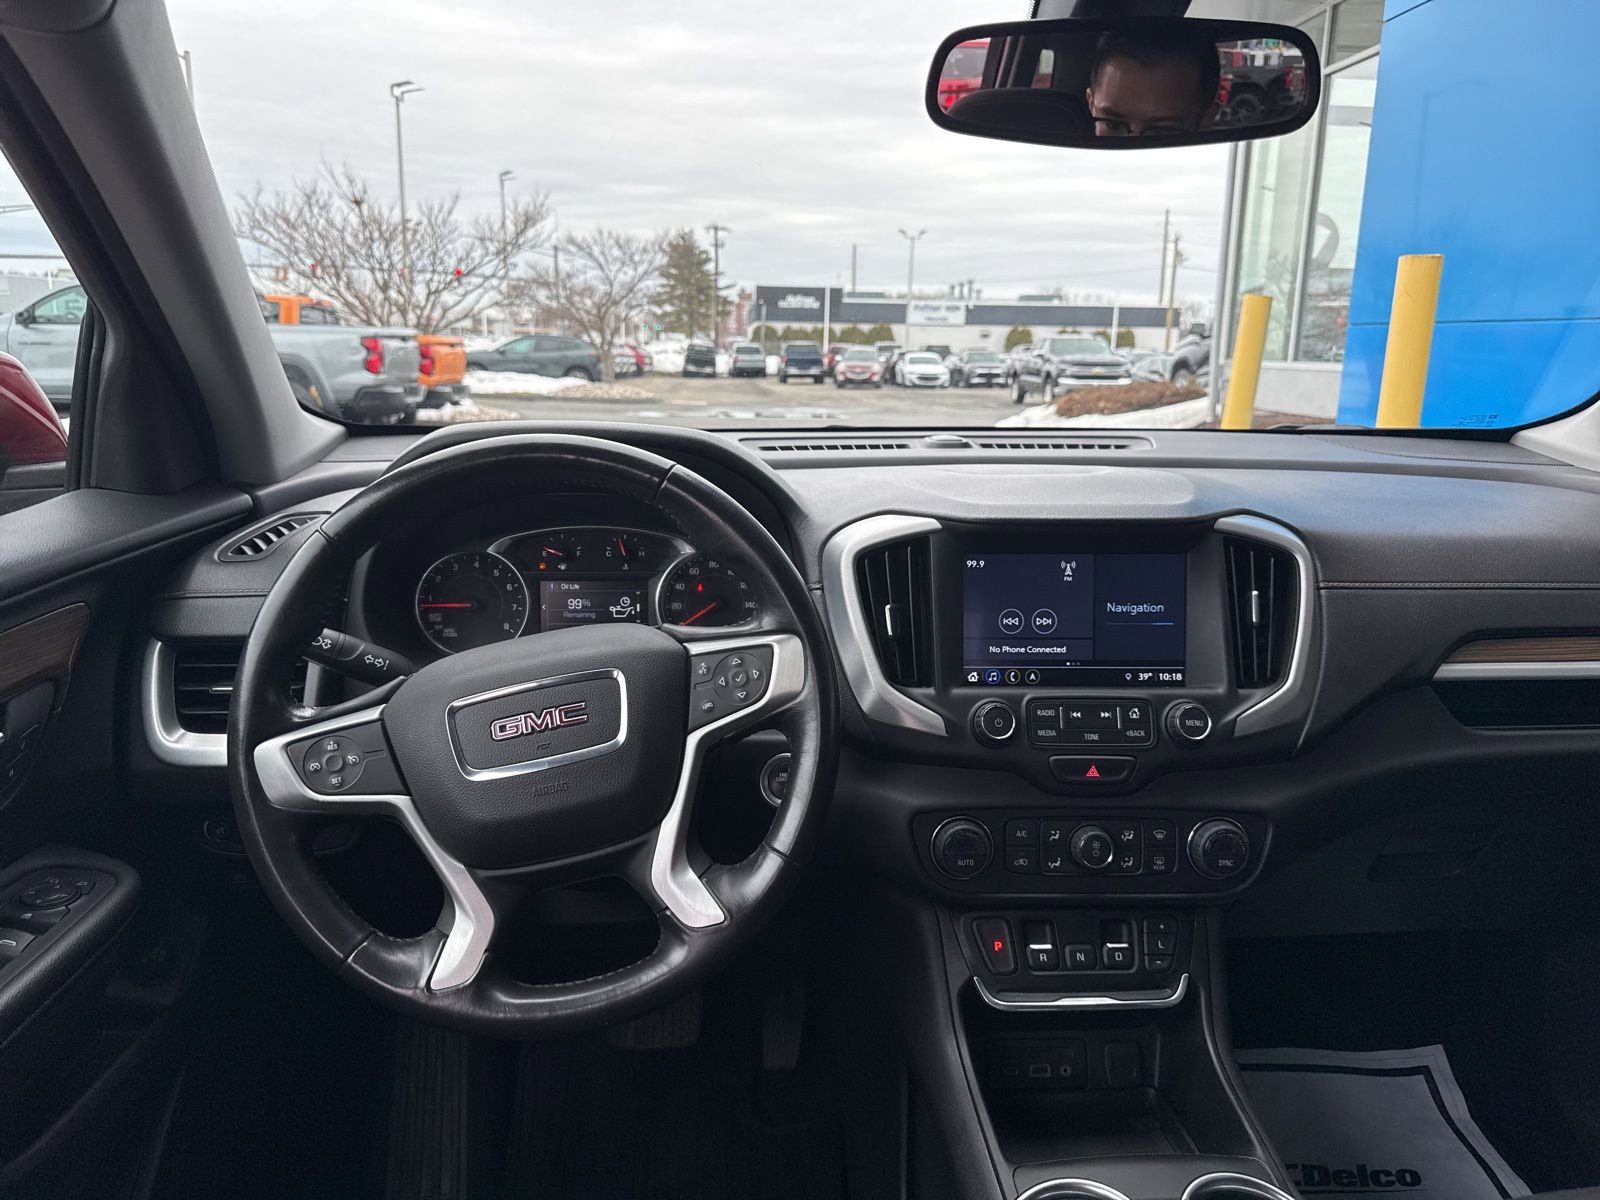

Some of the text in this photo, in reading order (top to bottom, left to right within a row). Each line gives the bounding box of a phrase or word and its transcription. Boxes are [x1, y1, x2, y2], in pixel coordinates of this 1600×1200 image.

[966, 560, 985, 568] 99.9
[568, 598, 591, 610] 99%
[671, 602, 682, 610] 20
[1107, 602, 1164, 615] Navigation
[563, 611, 596, 620] Remaining
[990, 646, 1067, 654] No Phone Connected
[1159, 672, 1182, 682] 10:18
[1037, 709, 1055, 717] RADIO
[491, 702, 589, 741] GMC
[1185, 719, 1203, 728] MENU
[1037, 729, 1056, 737] MEDIA
[1084, 733, 1099, 742] TONE
[331, 776, 342, 785] SET
[532, 781, 570, 798] AIRBAG
[1016, 830, 1027, 838] A/C
[1218, 859, 1234, 867] SYNC
[994, 941, 1002, 951] P
[1158, 941, 1164, 949] L
[1039, 953, 1048, 962] R
[1076, 952, 1085, 962] N
[1115, 952, 1123, 961] D
